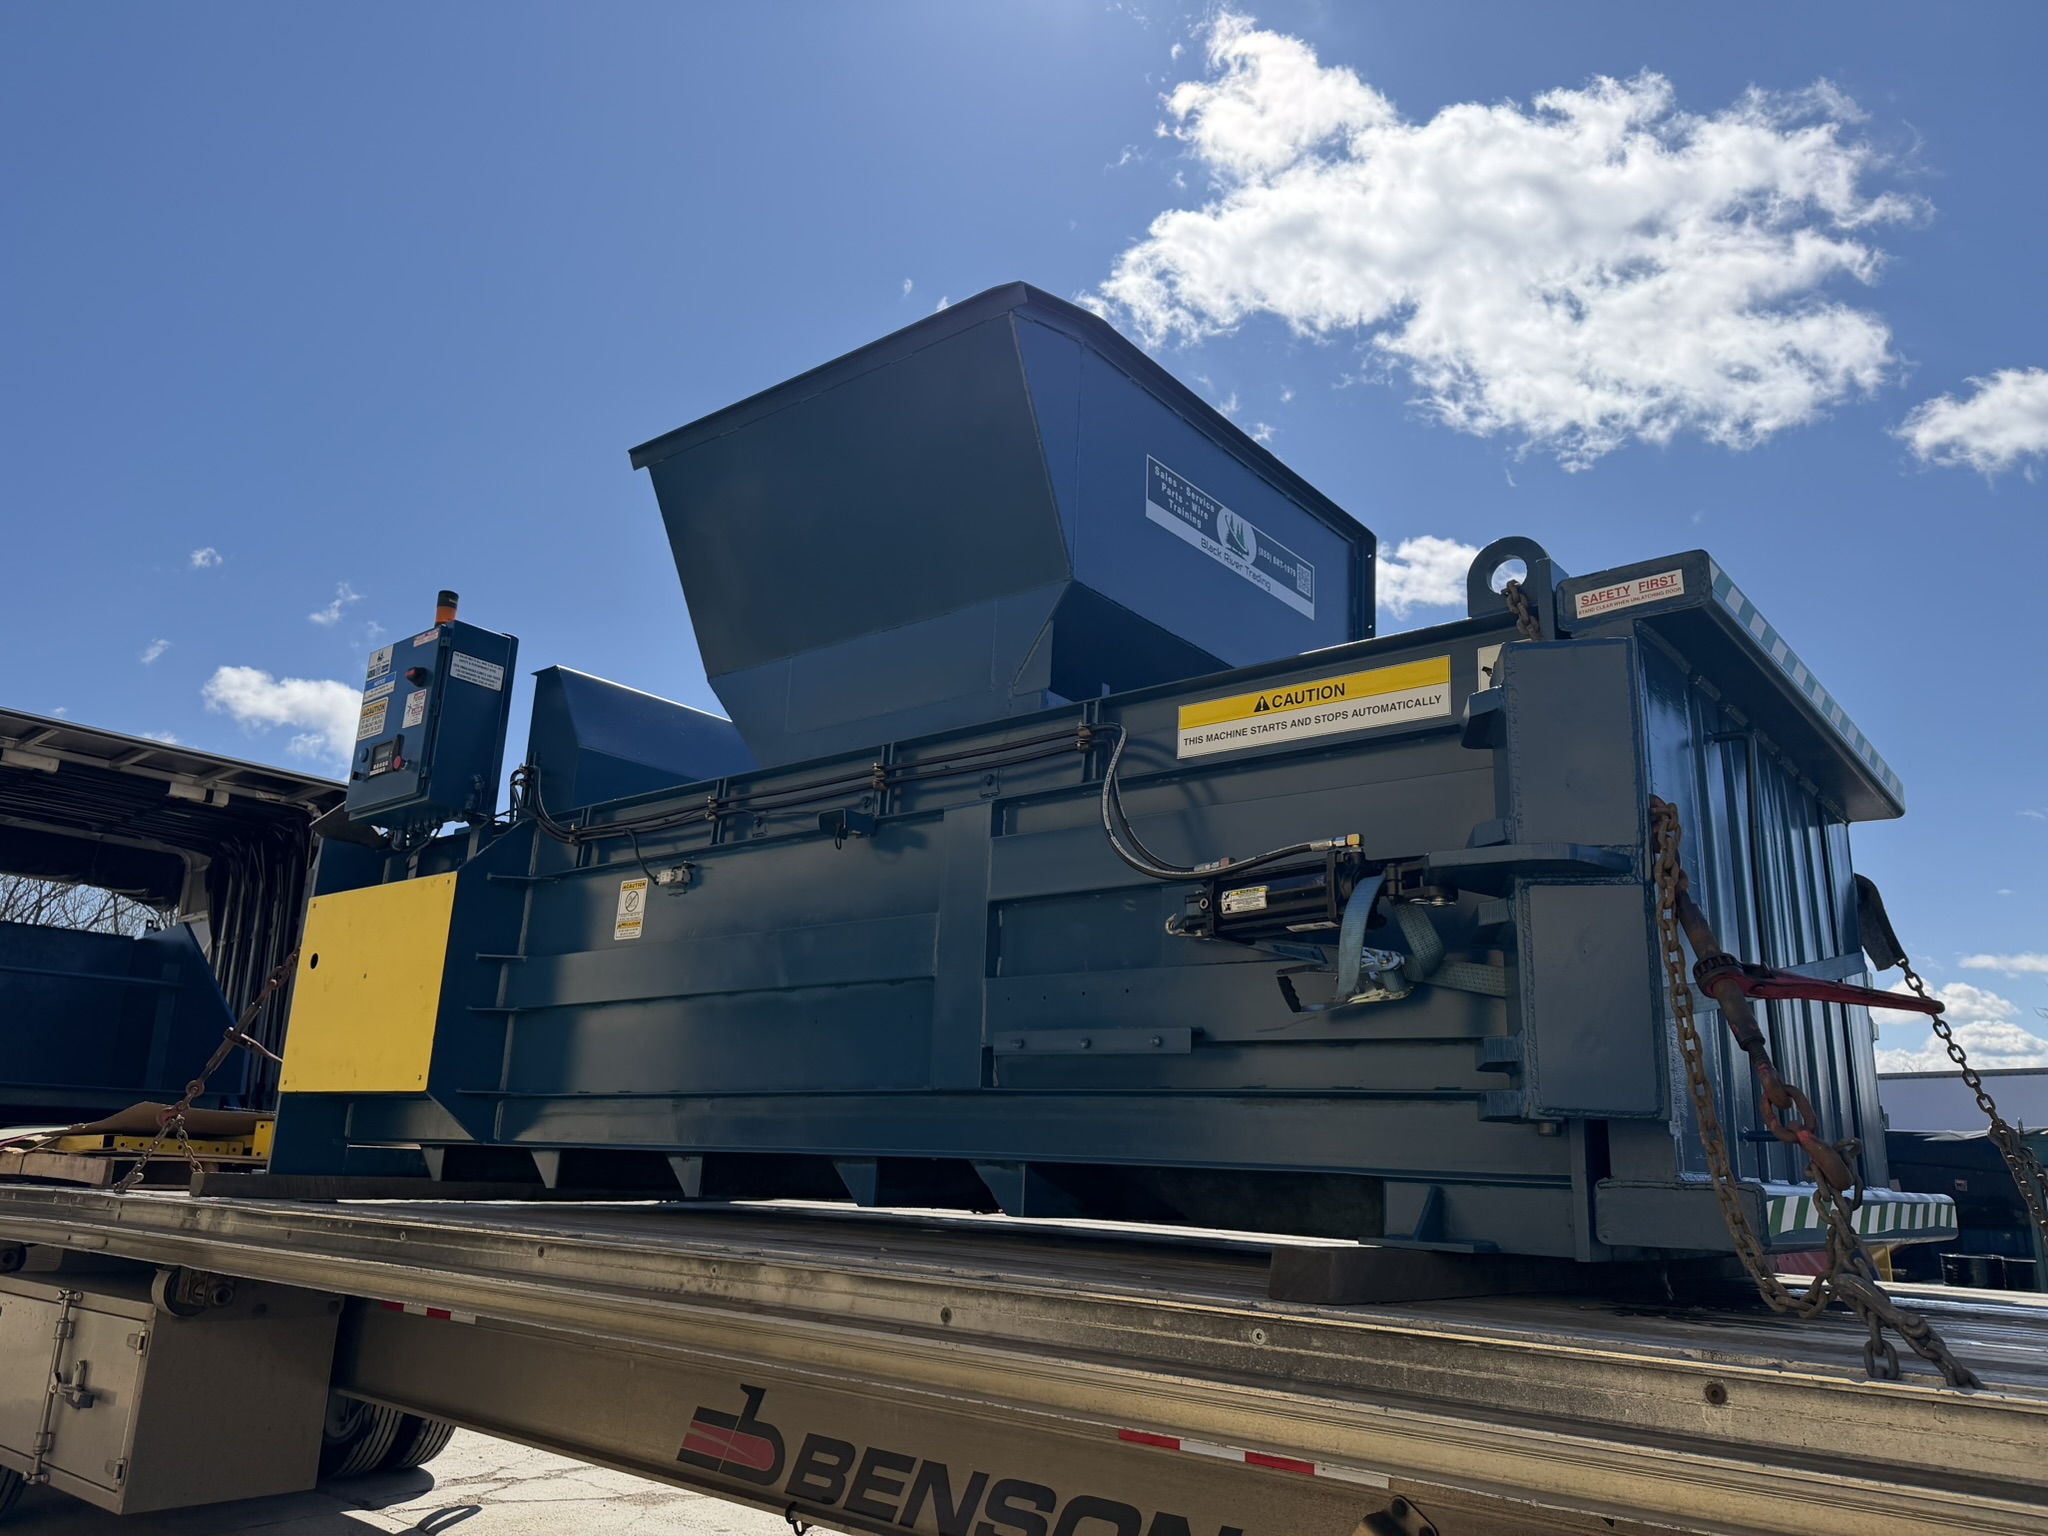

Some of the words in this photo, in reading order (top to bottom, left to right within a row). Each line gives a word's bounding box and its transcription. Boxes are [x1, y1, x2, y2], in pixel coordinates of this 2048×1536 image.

[1154, 465, 1177, 488] Sales
[1186, 486, 1215, 513] Service
[1161, 482, 1183, 503] Parts
[1191, 501, 1209, 520] Wire
[1168, 498, 1202, 529] Training
[1201, 538, 1222, 559] Black
[1223, 552, 1243, 572] River
[1245, 566, 1271, 592] Trading
[1578, 607, 1595, 615] STAND
[1596, 602, 1613, 611] CLEAR
[1614, 598, 1630, 607] WHEN
[1630, 590, 1665, 603] UNLATCHING
[1665, 586, 1682, 595] DOOR
[1581, 584, 1630, 606] SAFETY
[1638, 574, 1677, 591] FIRST
[1271, 685, 1346, 709] CAUTION
[1183, 735, 1204, 747] THIS
[1205, 727, 1248, 743] MACHINE
[1250, 720, 1288, 735] STARTS
[1289, 716, 1312, 729] AND
[1314, 710, 1349, 725] STOPS
[1351, 694, 1443, 719] AUTOMATICALLY
